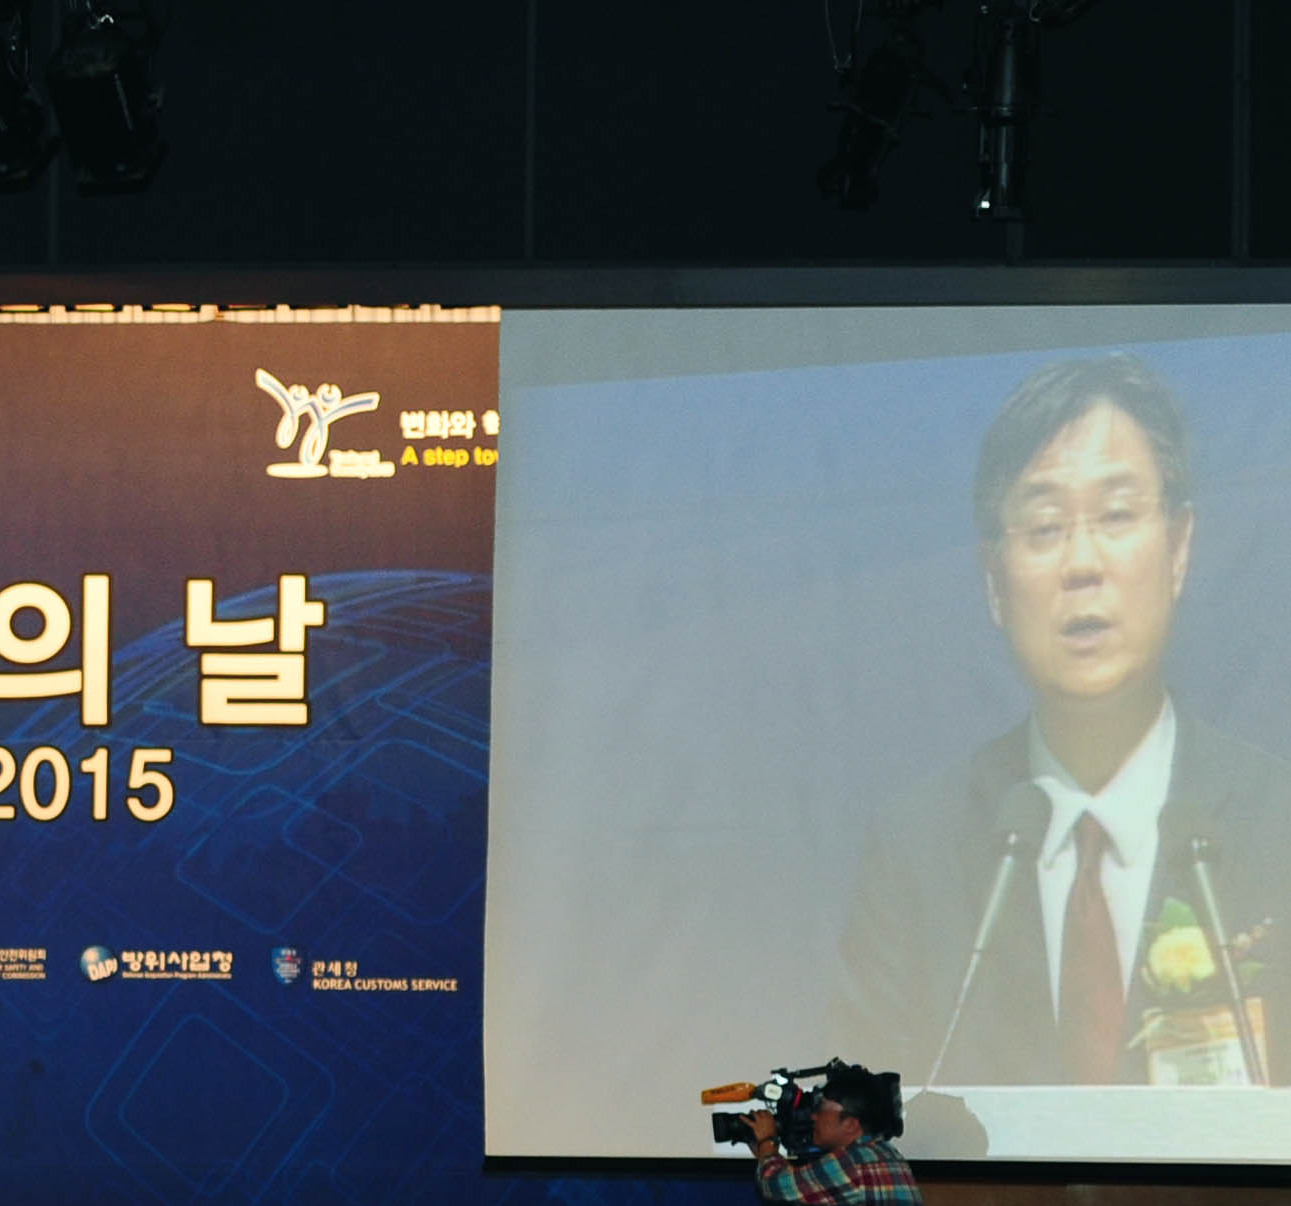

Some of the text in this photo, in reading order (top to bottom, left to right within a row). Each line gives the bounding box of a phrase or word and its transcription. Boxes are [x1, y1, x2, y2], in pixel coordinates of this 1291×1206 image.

[400, 445, 419, 466] A
[423, 446, 470, 468] step
[473, 446, 499, 466] to
[184, 573, 326, 727] 날
[121, 950, 233, 973] 방위사업청
[313, 977, 458, 991] KOREA CUSTOMS SERVICE
